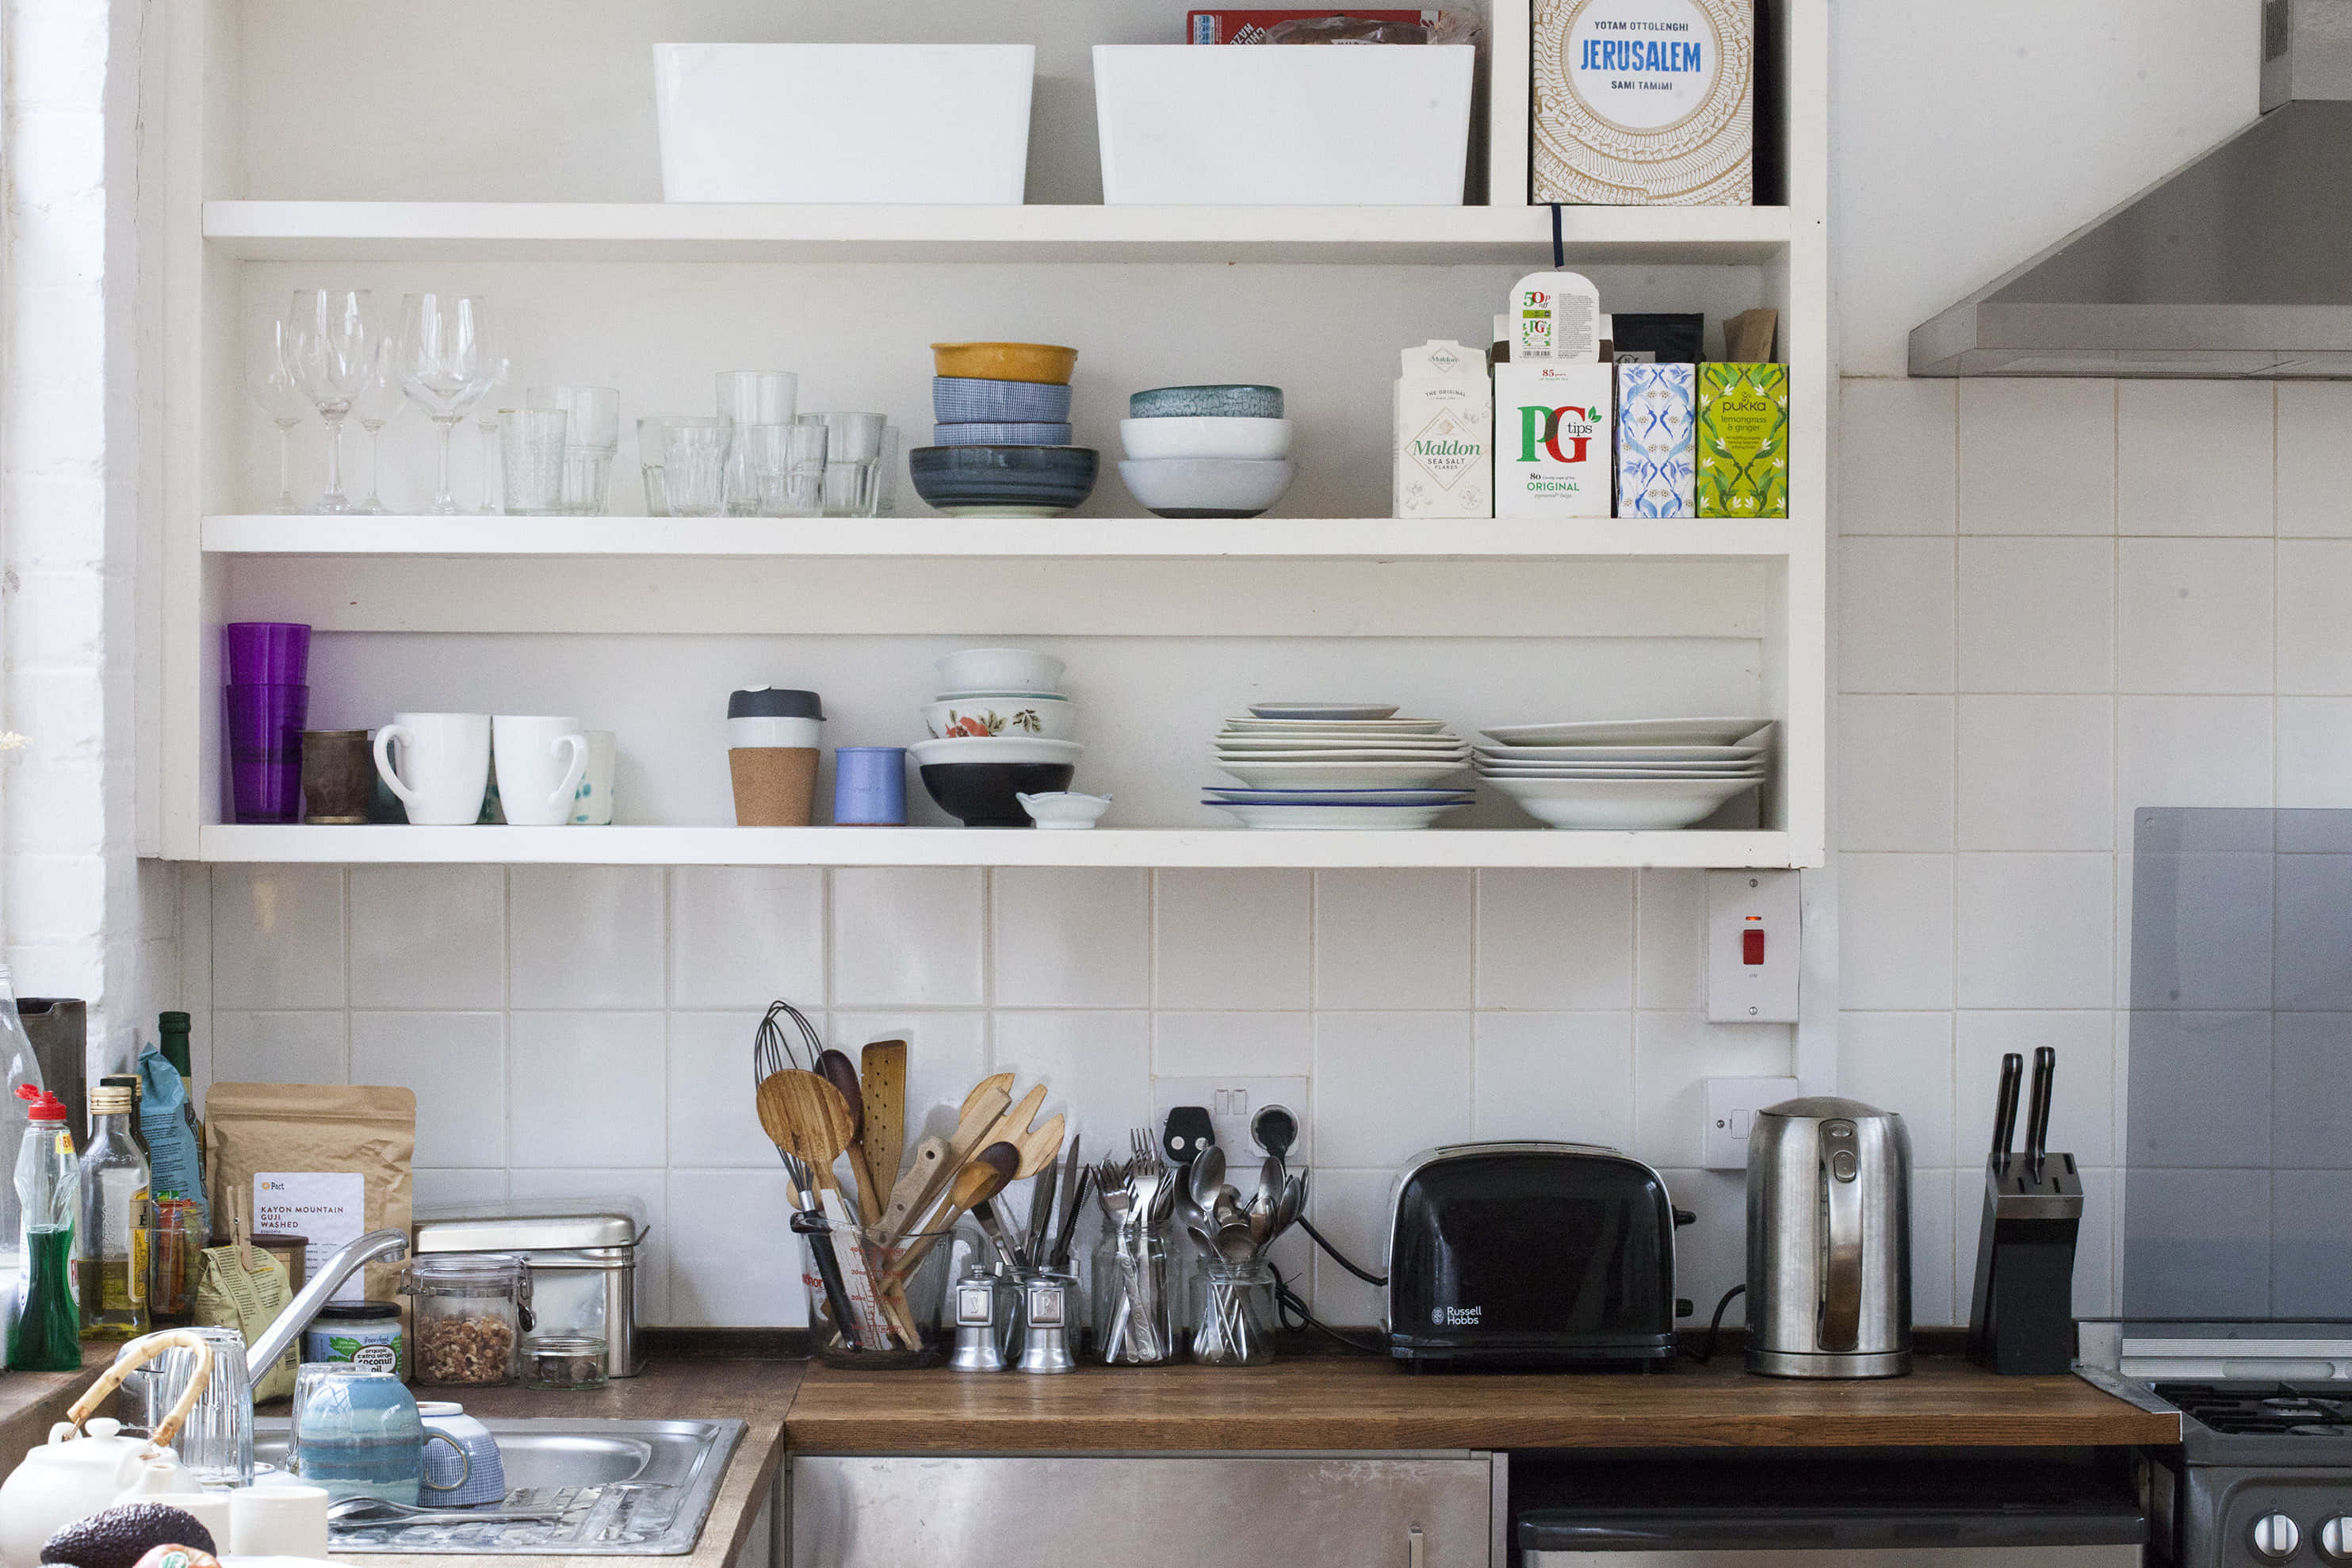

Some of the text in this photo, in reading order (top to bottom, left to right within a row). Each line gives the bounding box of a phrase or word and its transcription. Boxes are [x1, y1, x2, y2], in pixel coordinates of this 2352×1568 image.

[1595, 21, 1688, 32] YOTAM OTTOLENGHI
[1581, 40, 1701, 73] JERUSALEM
[1611, 81, 1673, 90] SAMI TAMIMI
[1542, 369, 1555, 377] 85
[1721, 415, 1767, 424] lemongrass
[1516, 405, 1593, 463] PG tips
[1413, 440, 1481, 456] Maldon
[1527, 482, 1580, 491] ORIGINAL
[1040, 1296, 1051, 1315] P
[1447, 1306, 1482, 1316] Russell
[1447, 1315, 1479, 1325] Hobbs
